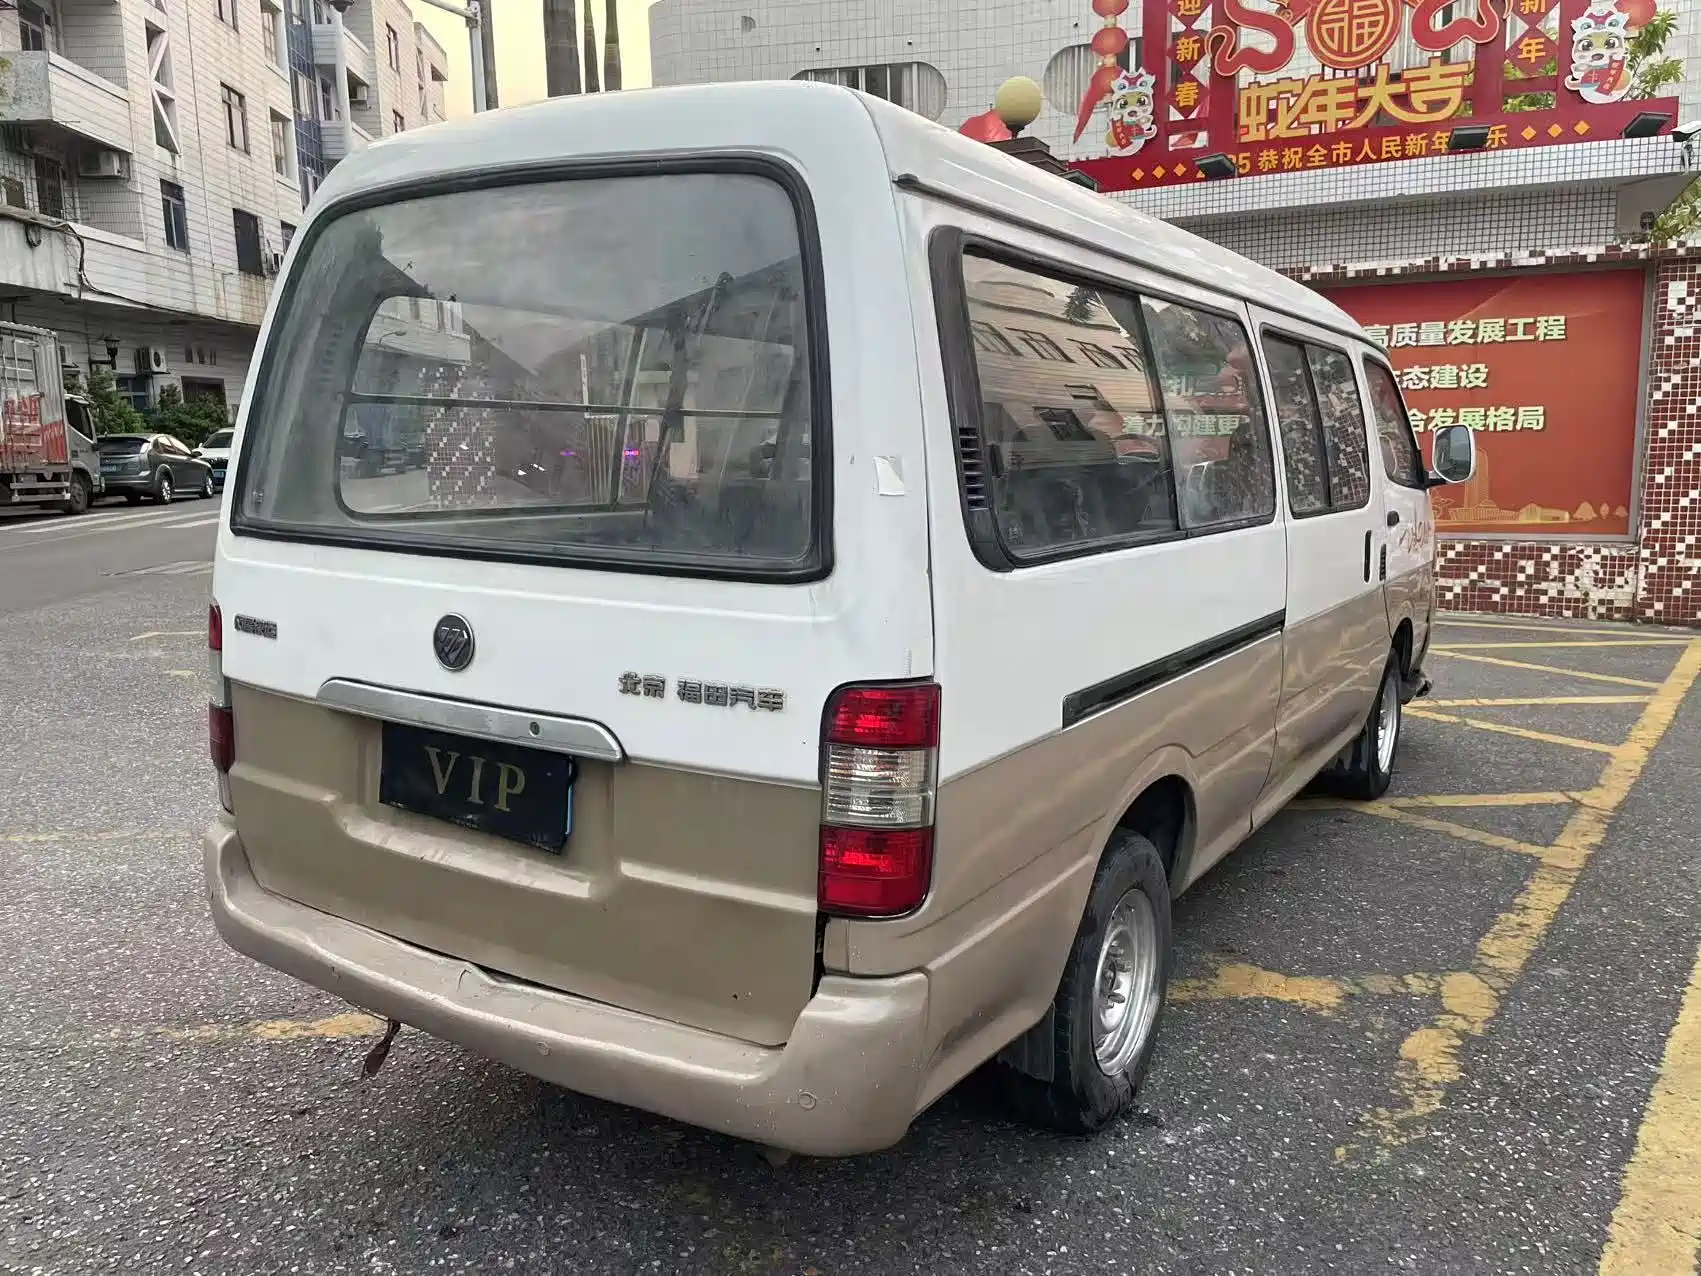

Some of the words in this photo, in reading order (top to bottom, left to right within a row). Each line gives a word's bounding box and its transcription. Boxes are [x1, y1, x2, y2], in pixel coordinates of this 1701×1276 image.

[1239, 57, 1472, 143] 蛇年大吉
[1258, 125, 1507, 172] 恭祝全市人民新年乐
[1362, 315, 1567, 348] 高质量发展工程
[618, 671, 666, 699] 北京
[677, 677, 784, 712] 福田汽车
[423, 745, 526, 812] VIP
